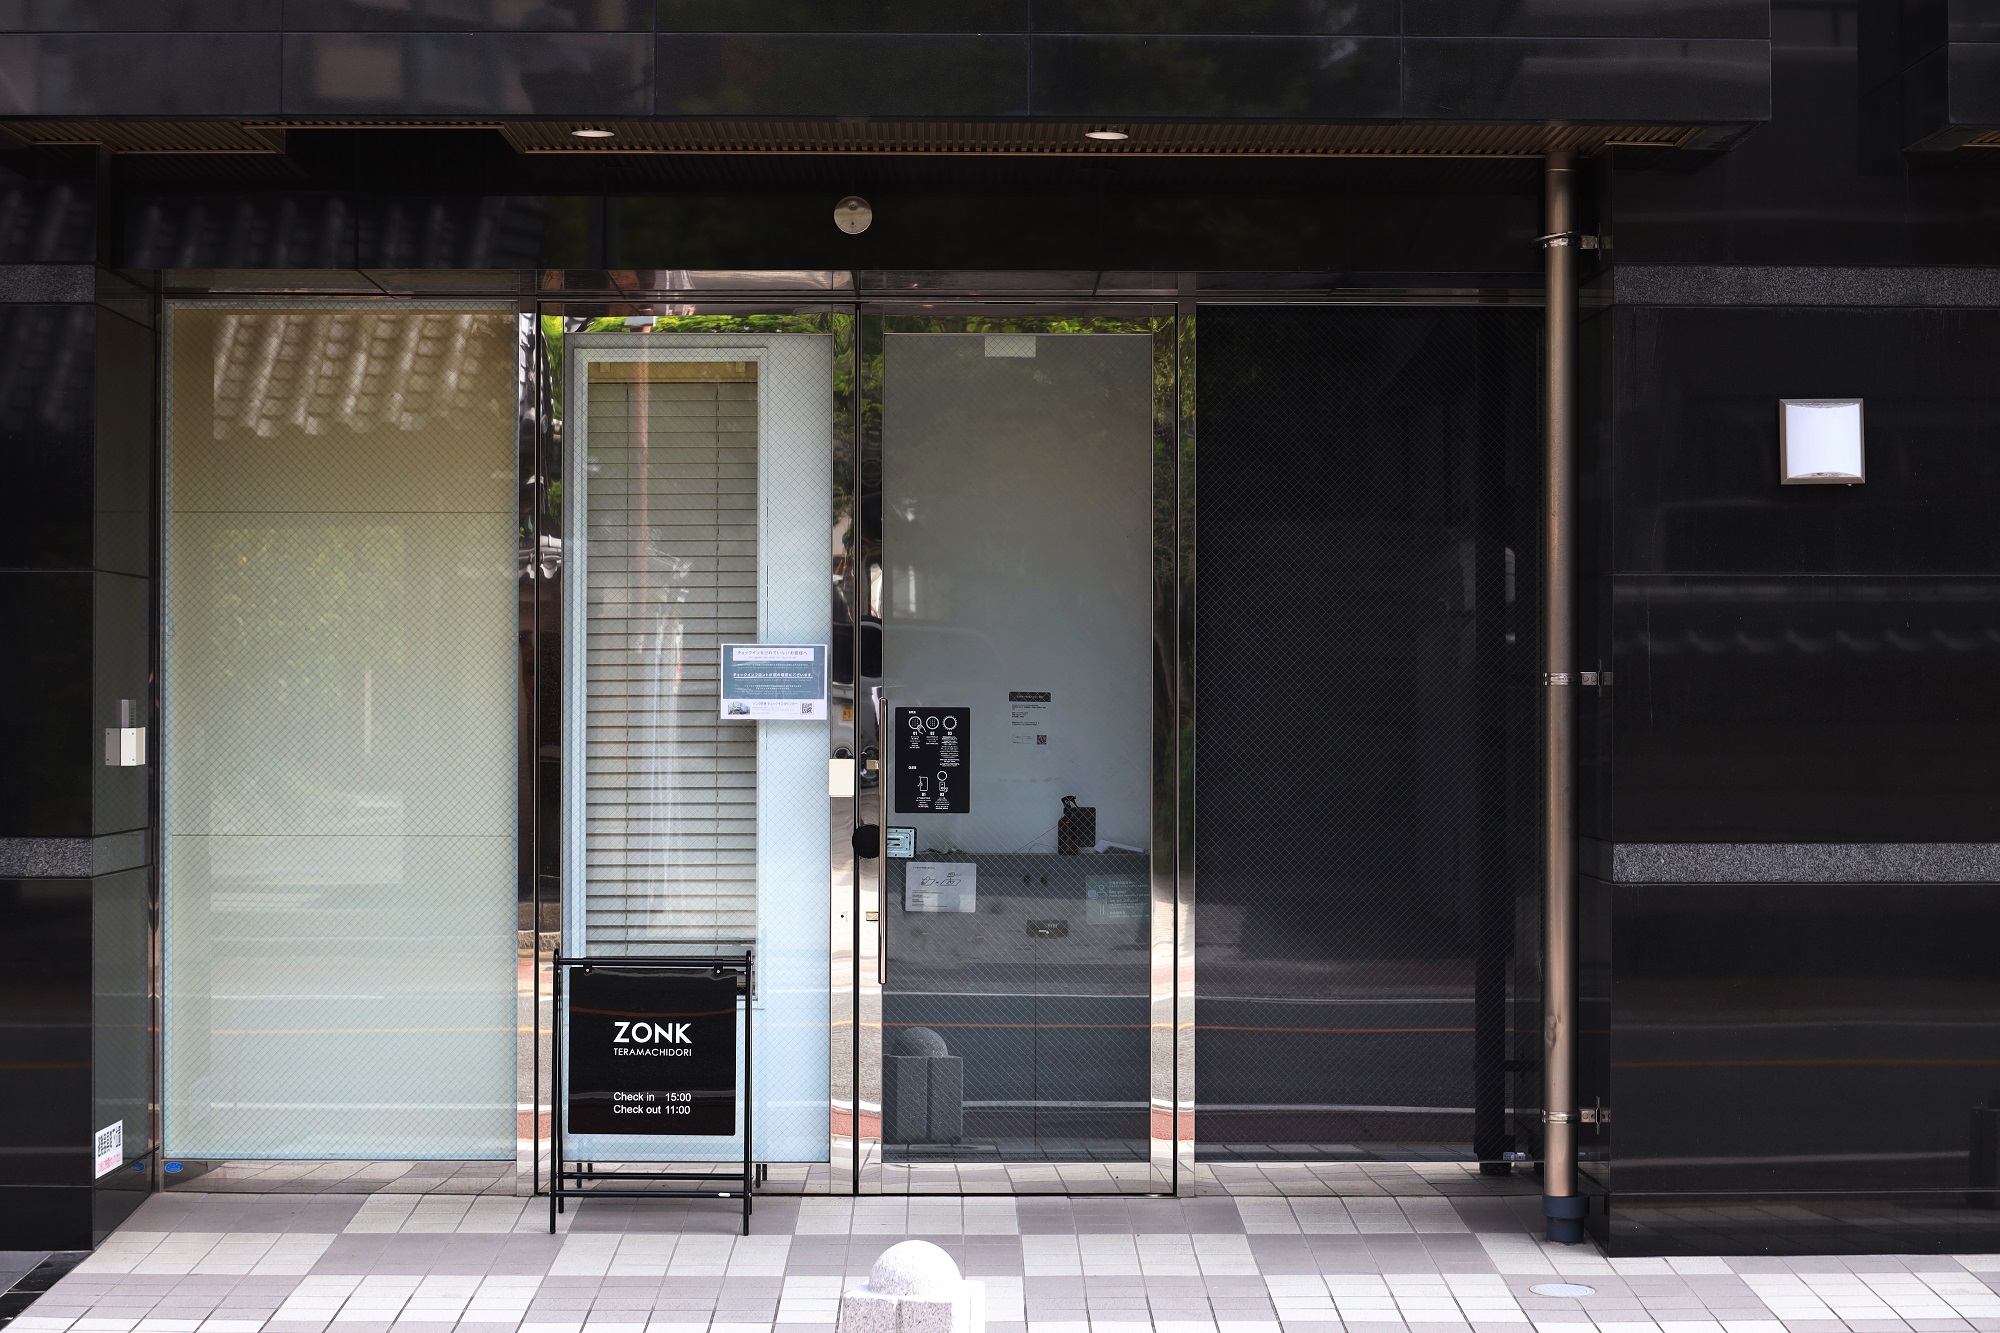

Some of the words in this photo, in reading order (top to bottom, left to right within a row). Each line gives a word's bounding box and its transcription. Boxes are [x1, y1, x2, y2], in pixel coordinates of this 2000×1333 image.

[613, 1021, 692, 1044] ZONK
[613, 1047, 692, 1057] TERAMACHIDORI
[613, 1092, 644, 1102] Check
[646, 1092, 655, 1102] in
[666, 1093, 692, 1102] 15:00
[613, 1105, 644, 1114] Check
[646, 1106, 661, 1114] out
[666, 1105, 691, 1115] 11:00
